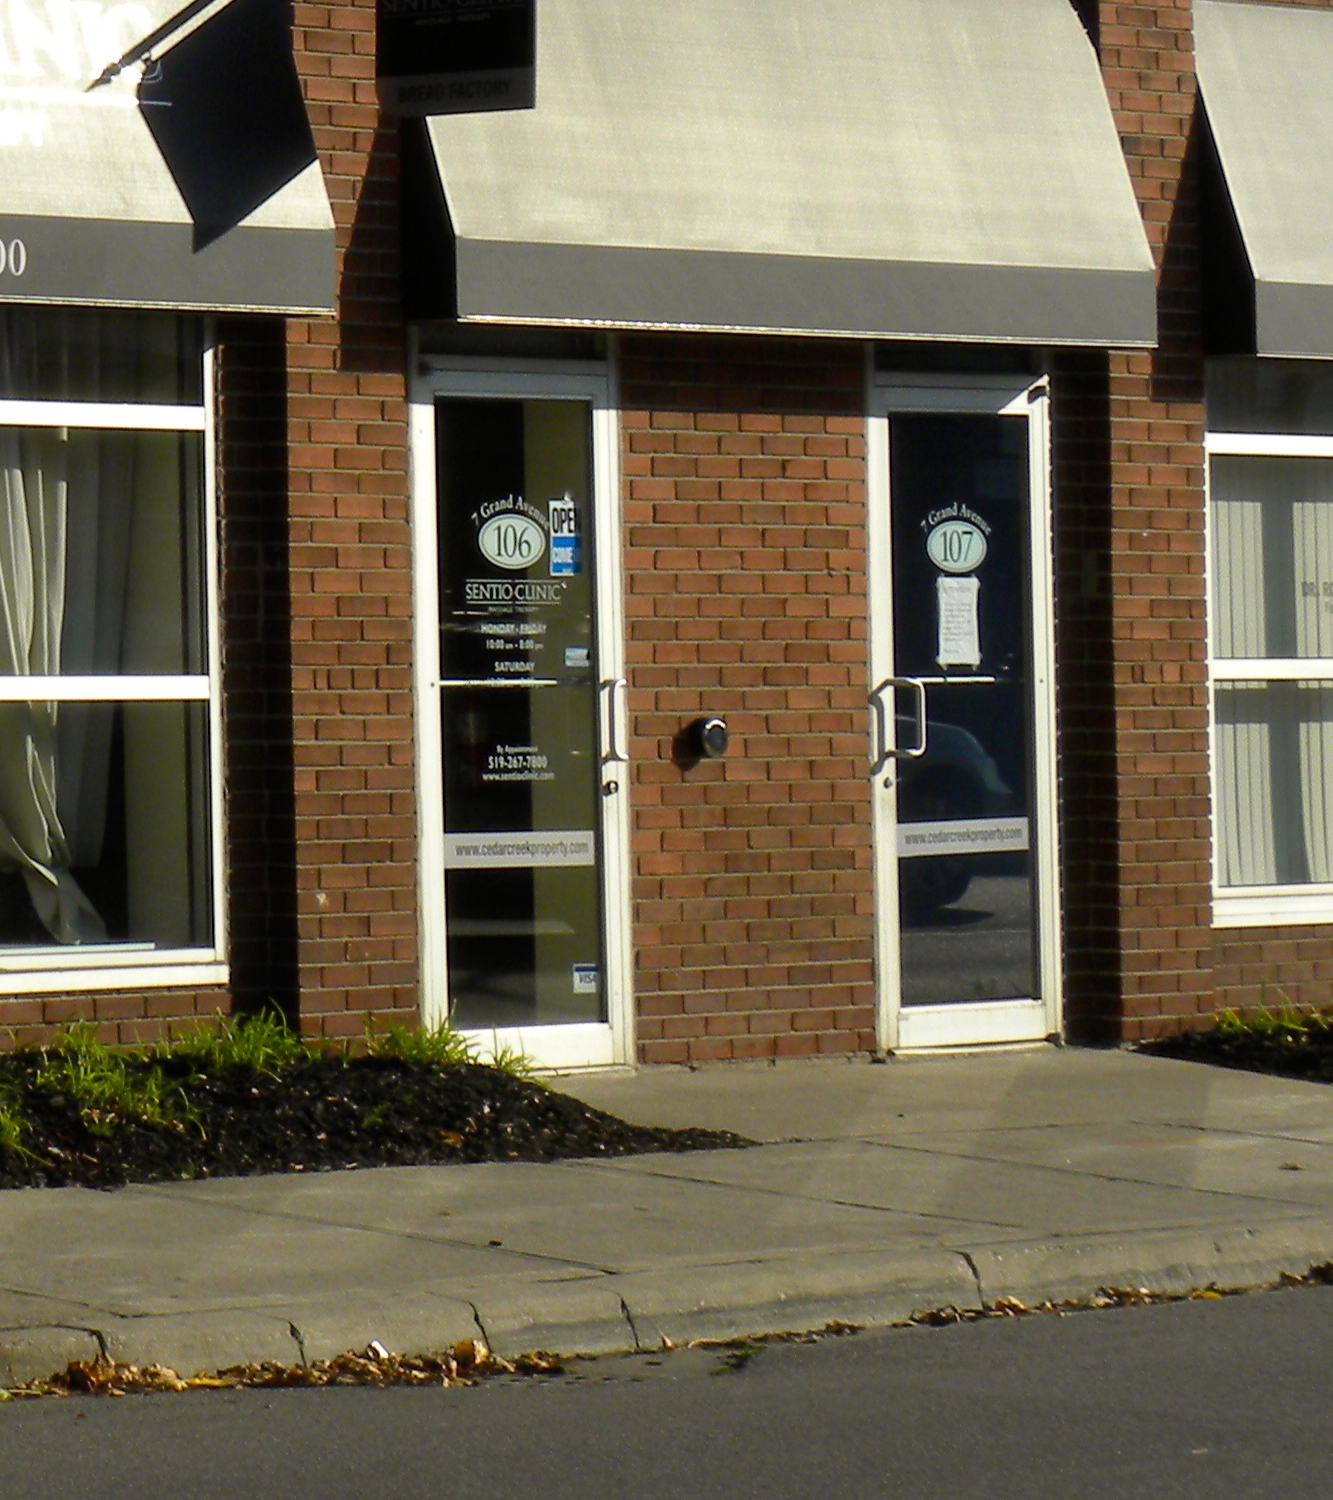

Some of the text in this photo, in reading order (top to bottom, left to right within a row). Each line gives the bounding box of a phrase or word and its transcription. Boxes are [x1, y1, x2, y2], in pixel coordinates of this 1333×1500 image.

[480, 493, 513, 518] Grand
[515, 496, 550, 531] Avenue
[928, 502, 958, 526] Grand
[959, 503, 992, 536] Avenue
[493, 523, 532, 559] 106
[940, 529, 974, 563] 107
[480, 623, 515, 634] MONDAY
[494, 661, 536, 672] SATURDAY
[455, 840, 589, 858] www.cedarcreekproperty.com
[904, 827, 1023, 845] www.cedarcreekproperty.com
